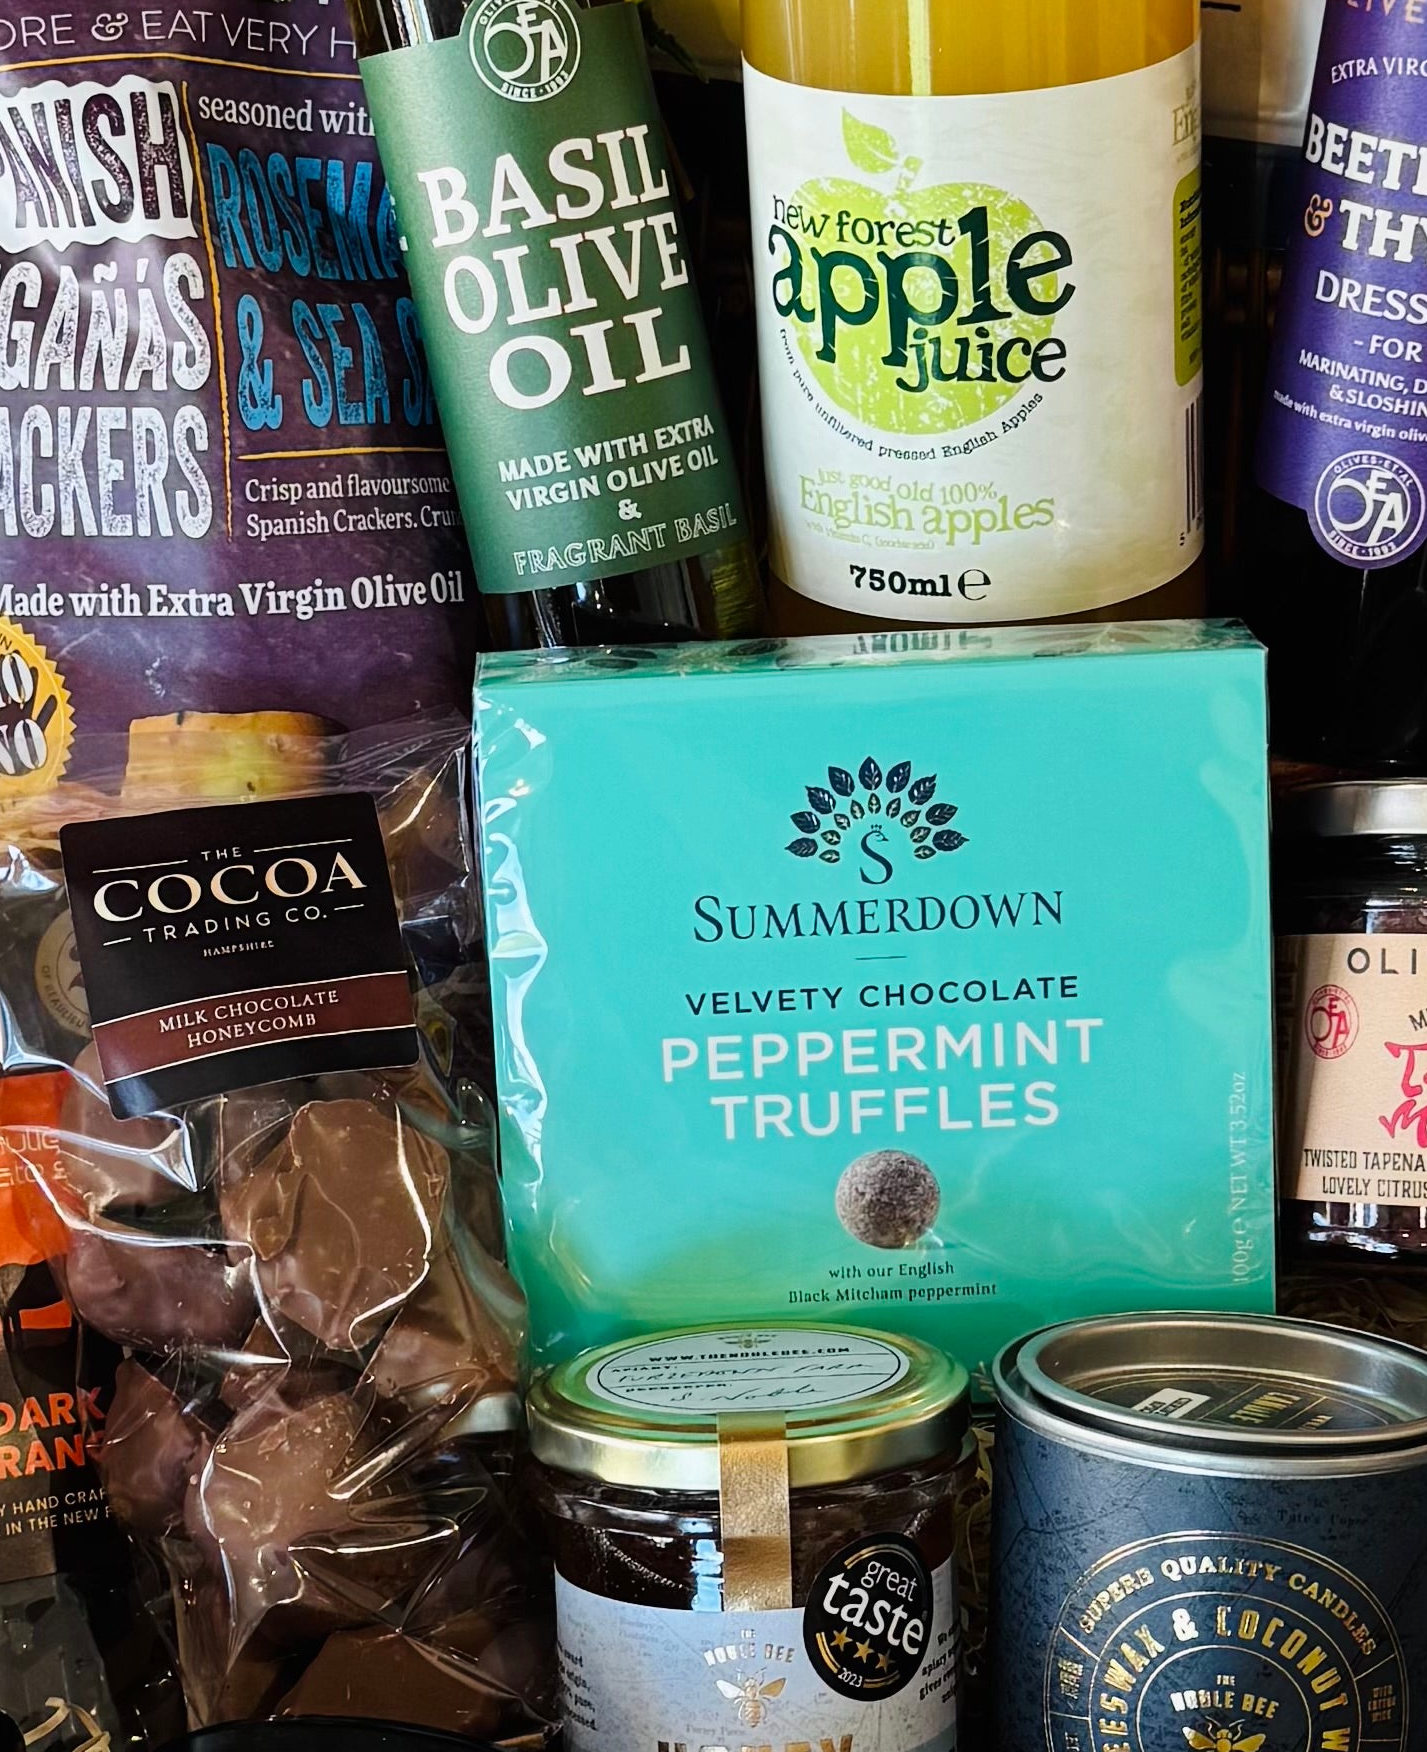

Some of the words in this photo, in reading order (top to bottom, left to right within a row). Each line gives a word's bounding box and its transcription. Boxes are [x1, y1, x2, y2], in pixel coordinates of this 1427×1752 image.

[418, 123, 670, 250] BASIL
[1303, 193, 1333, 237] &
[773, 194, 831, 240] new
[836, 210, 957, 248] forest
[443, 212, 689, 335] OLIVE
[768, 206, 1076, 367] apple
[489, 306, 692, 410] OIL
[895, 326, 1068, 393] juice
[799, 475, 914, 531] English
[922, 498, 1055, 546] apples
[71, 583, 140, 616] with
[146, 583, 233, 618] Extra
[239, 577, 346, 622] Virgin
[350, 573, 427, 609] Olive
[431, 570, 464, 606] Oil
[849, 564, 952, 598] 750ml
[92, 851, 367, 922] COCOA
[691, 890, 1065, 944] SUMMERDOWN
[159, 1010, 208, 1034] MILK
[214, 990, 340, 1021] CHOCOLATE
[187, 1013, 317, 1048] HONEYCOMB
[661, 1018, 1105, 1083] PEPPERMINT
[711, 1081, 1061, 1140] TRUFFLES
[1303, 1148, 1357, 1170] TWISTED
[787, 1287, 830, 1305] Black
[836, 1284, 903, 1304] Mitcham
[907, 1281, 998, 1305] peppermint
[866, 1560, 917, 1602] great
[1160, 1554, 1282, 1582] QUALITY
[1287, 1573, 1377, 1657] CANDLES
[822, 1571, 926, 1656] taste
